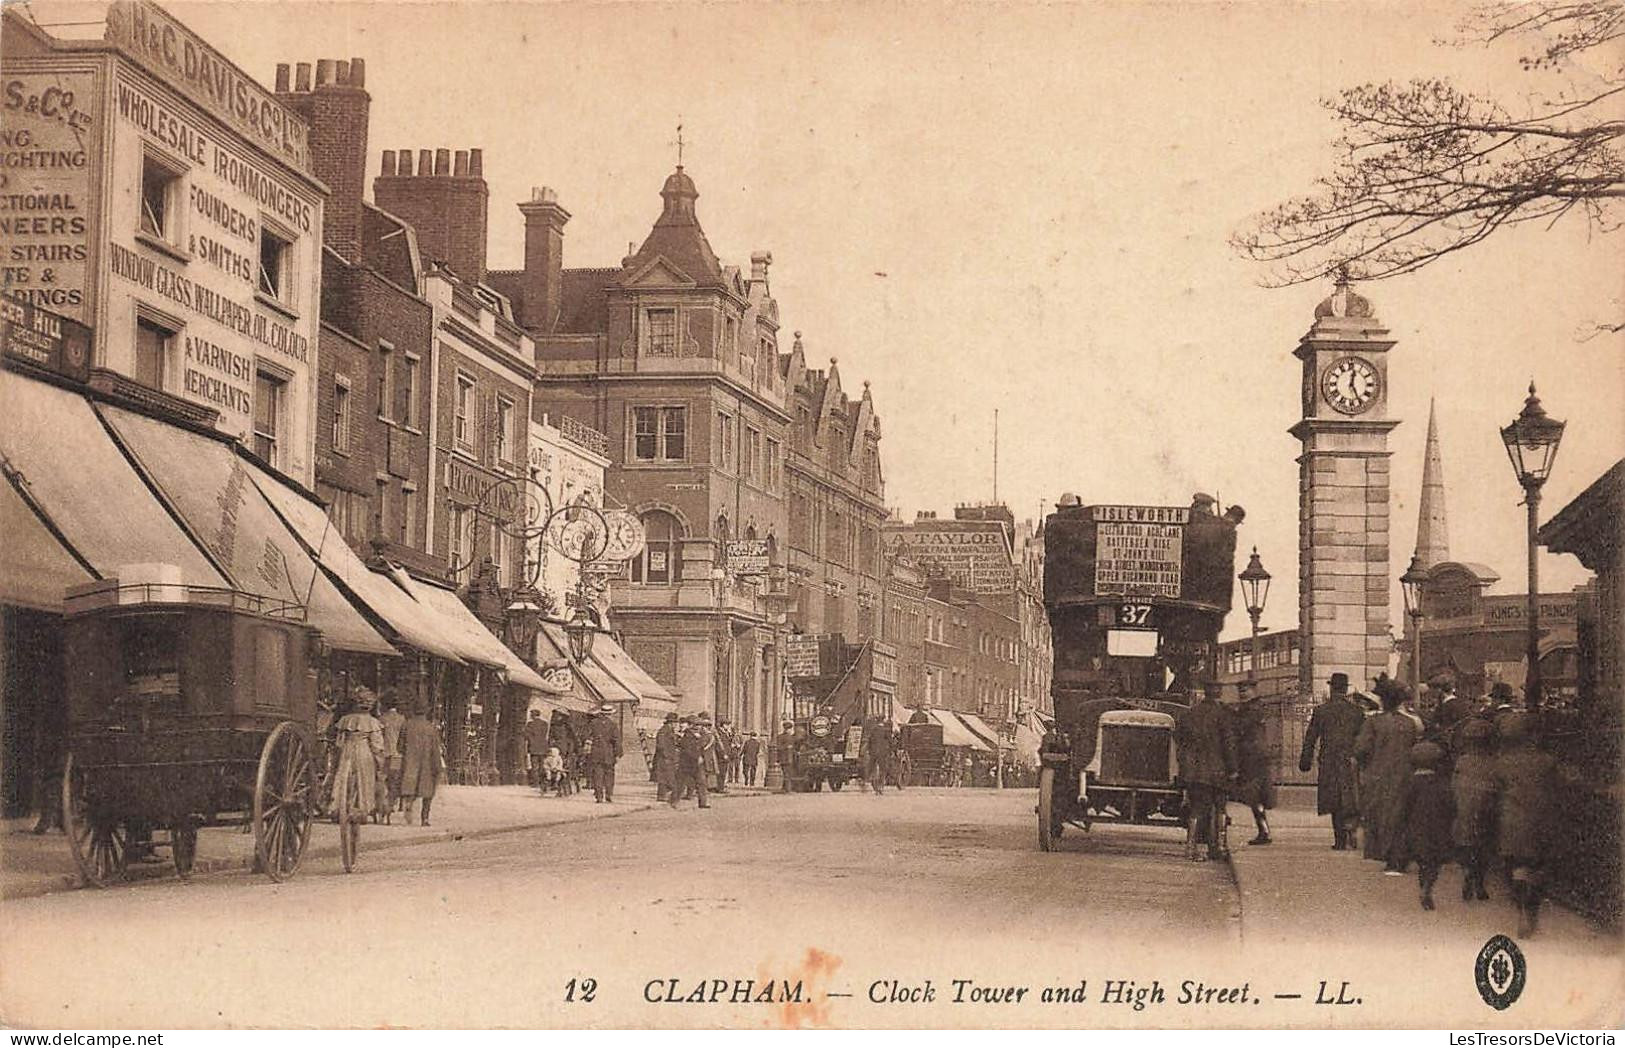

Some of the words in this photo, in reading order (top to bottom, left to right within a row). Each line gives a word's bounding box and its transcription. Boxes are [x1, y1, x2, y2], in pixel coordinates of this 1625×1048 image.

[118, 82, 206, 166] WHOLESALE
[190, 183, 256, 243] FOUNDERS
[11, 244, 87, 261] STAIRS
[41, 268, 55, 282] &
[110, 242, 155, 290] WINDOW
[195, 336, 250, 382] VARNISH
[185, 367, 250, 414] MERCHANTS
[1102, 507, 1183, 522] ISLEWORTH
[1122, 606, 1152, 624] 37
